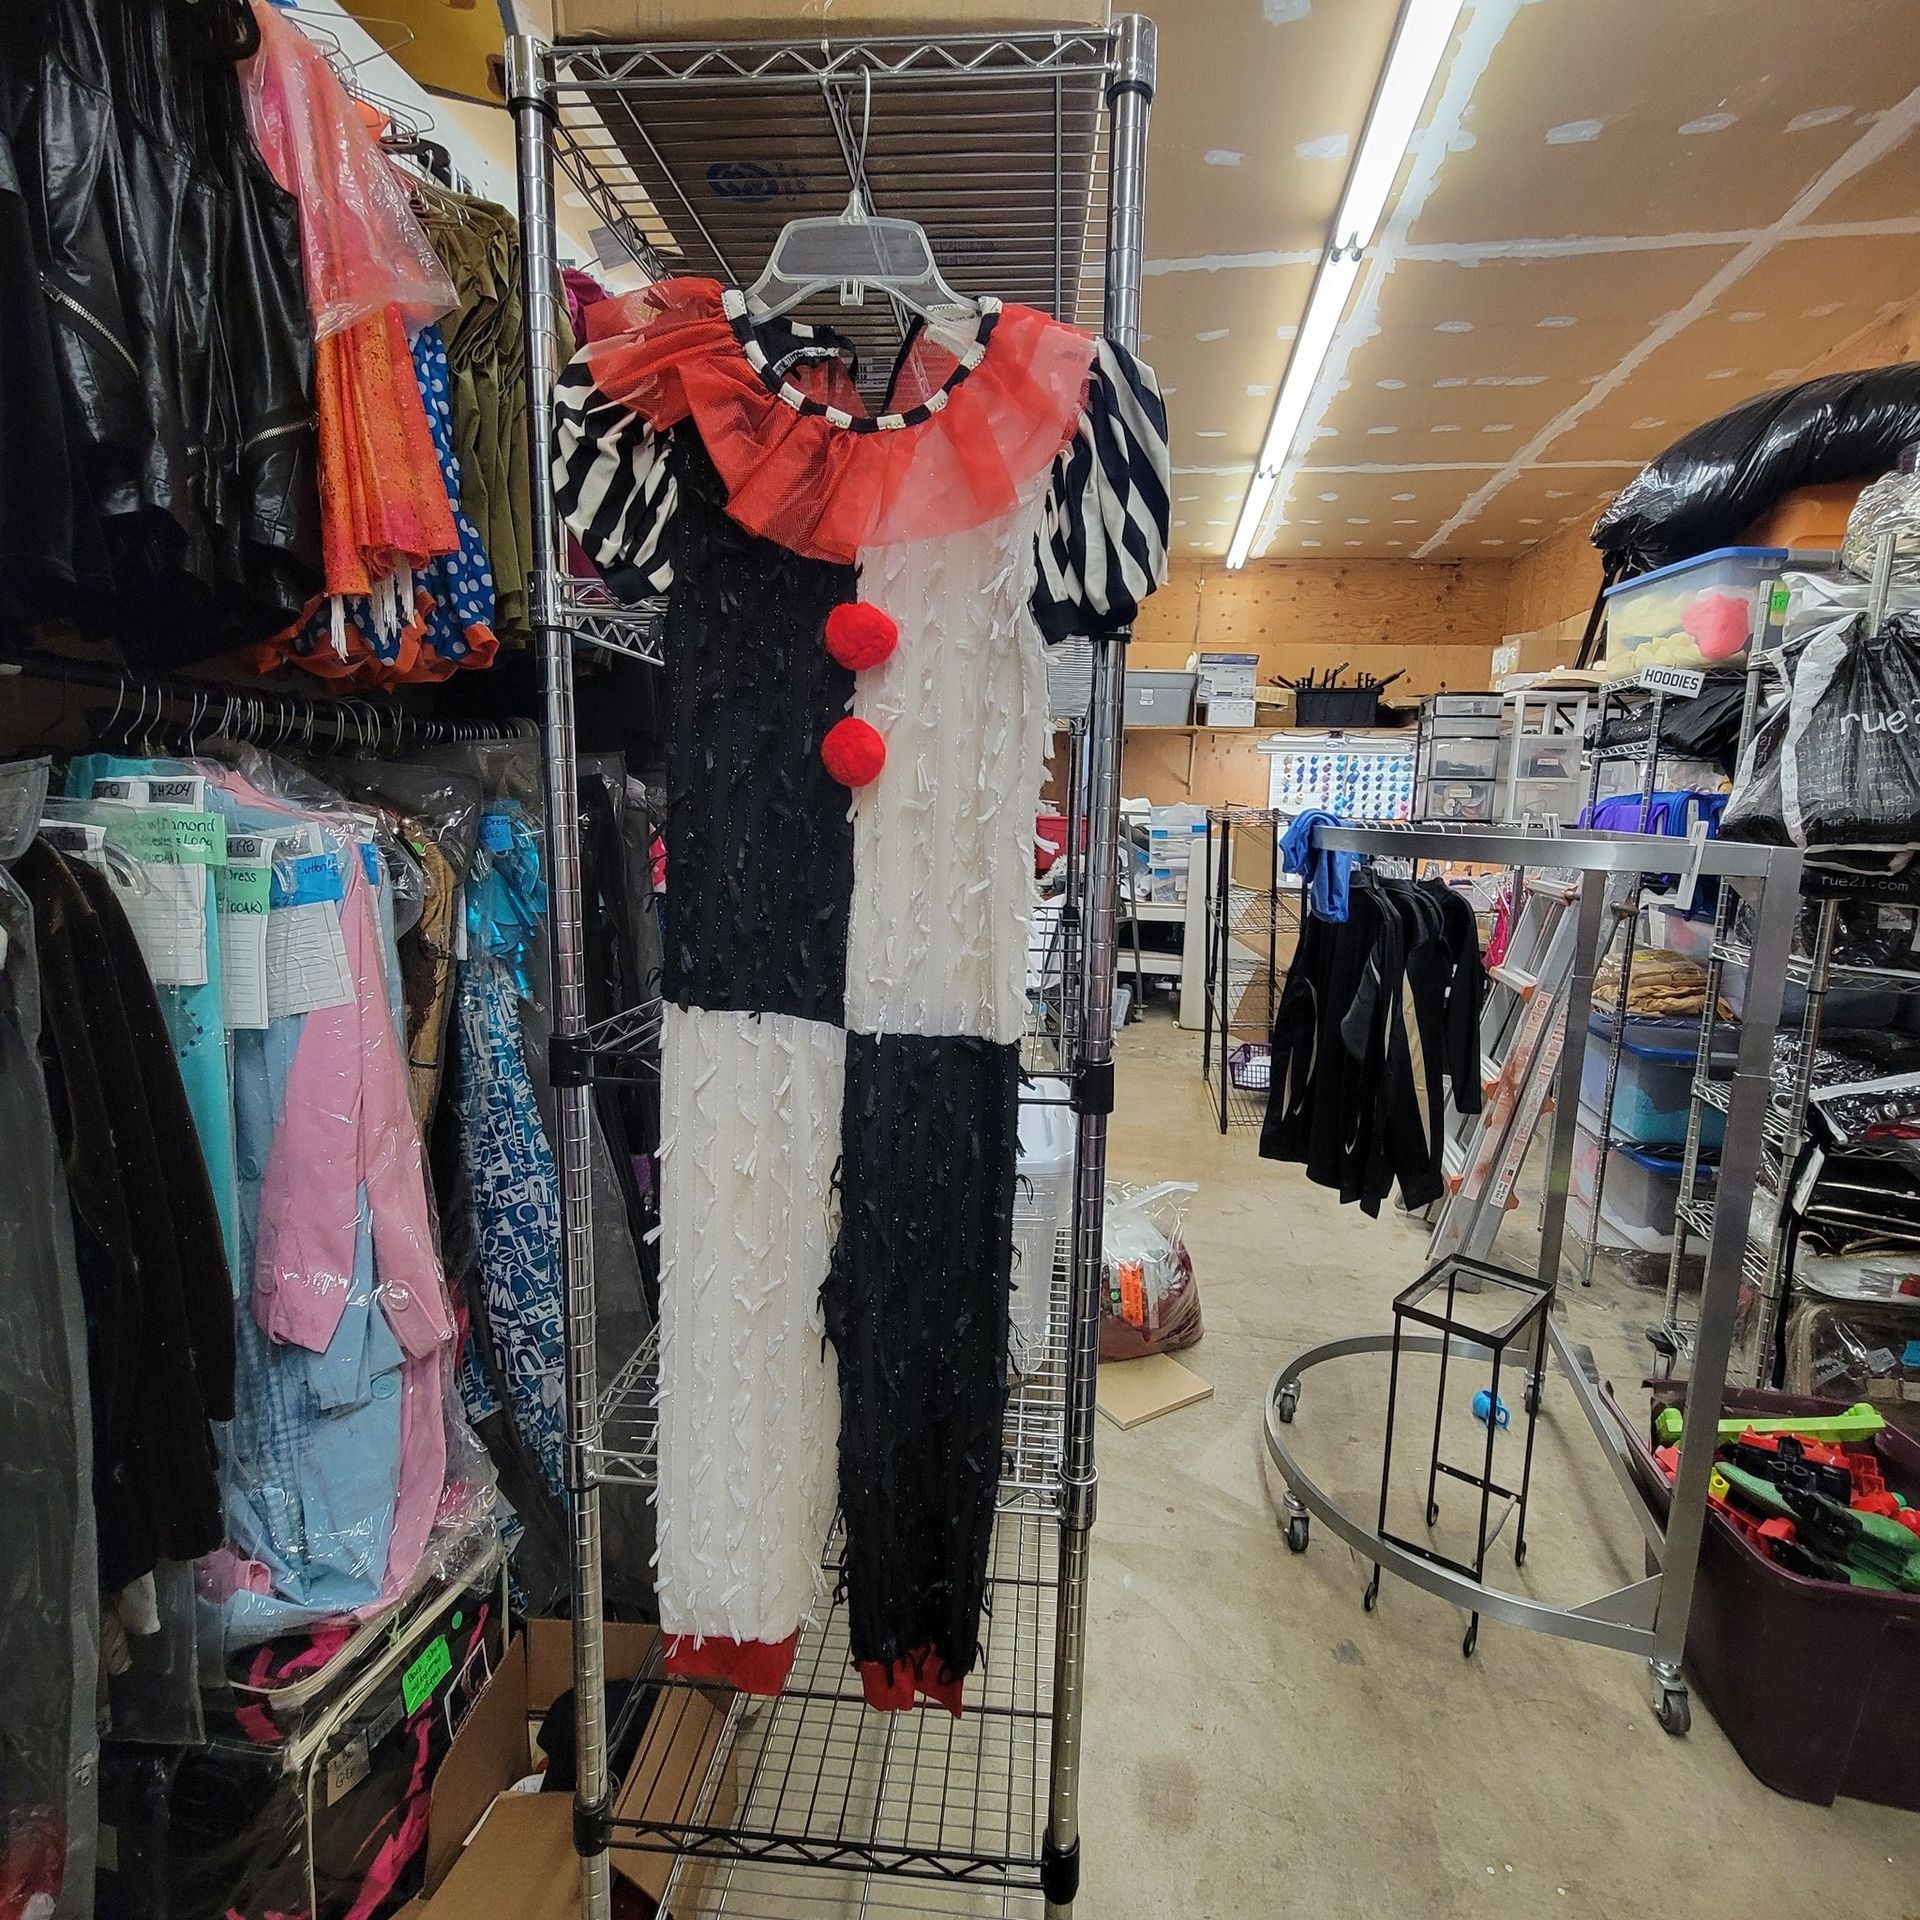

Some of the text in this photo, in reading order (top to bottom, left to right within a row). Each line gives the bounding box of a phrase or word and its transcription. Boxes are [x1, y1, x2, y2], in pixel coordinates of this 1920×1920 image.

[1644, 669, 1699, 691] HOODIES
[1826, 783, 1859, 794] ue21
[1820, 795, 1912, 811] rue21 rue21
[1822, 813, 1911, 828] rue21 rue21
[1822, 875, 1909, 893] rue21.com
